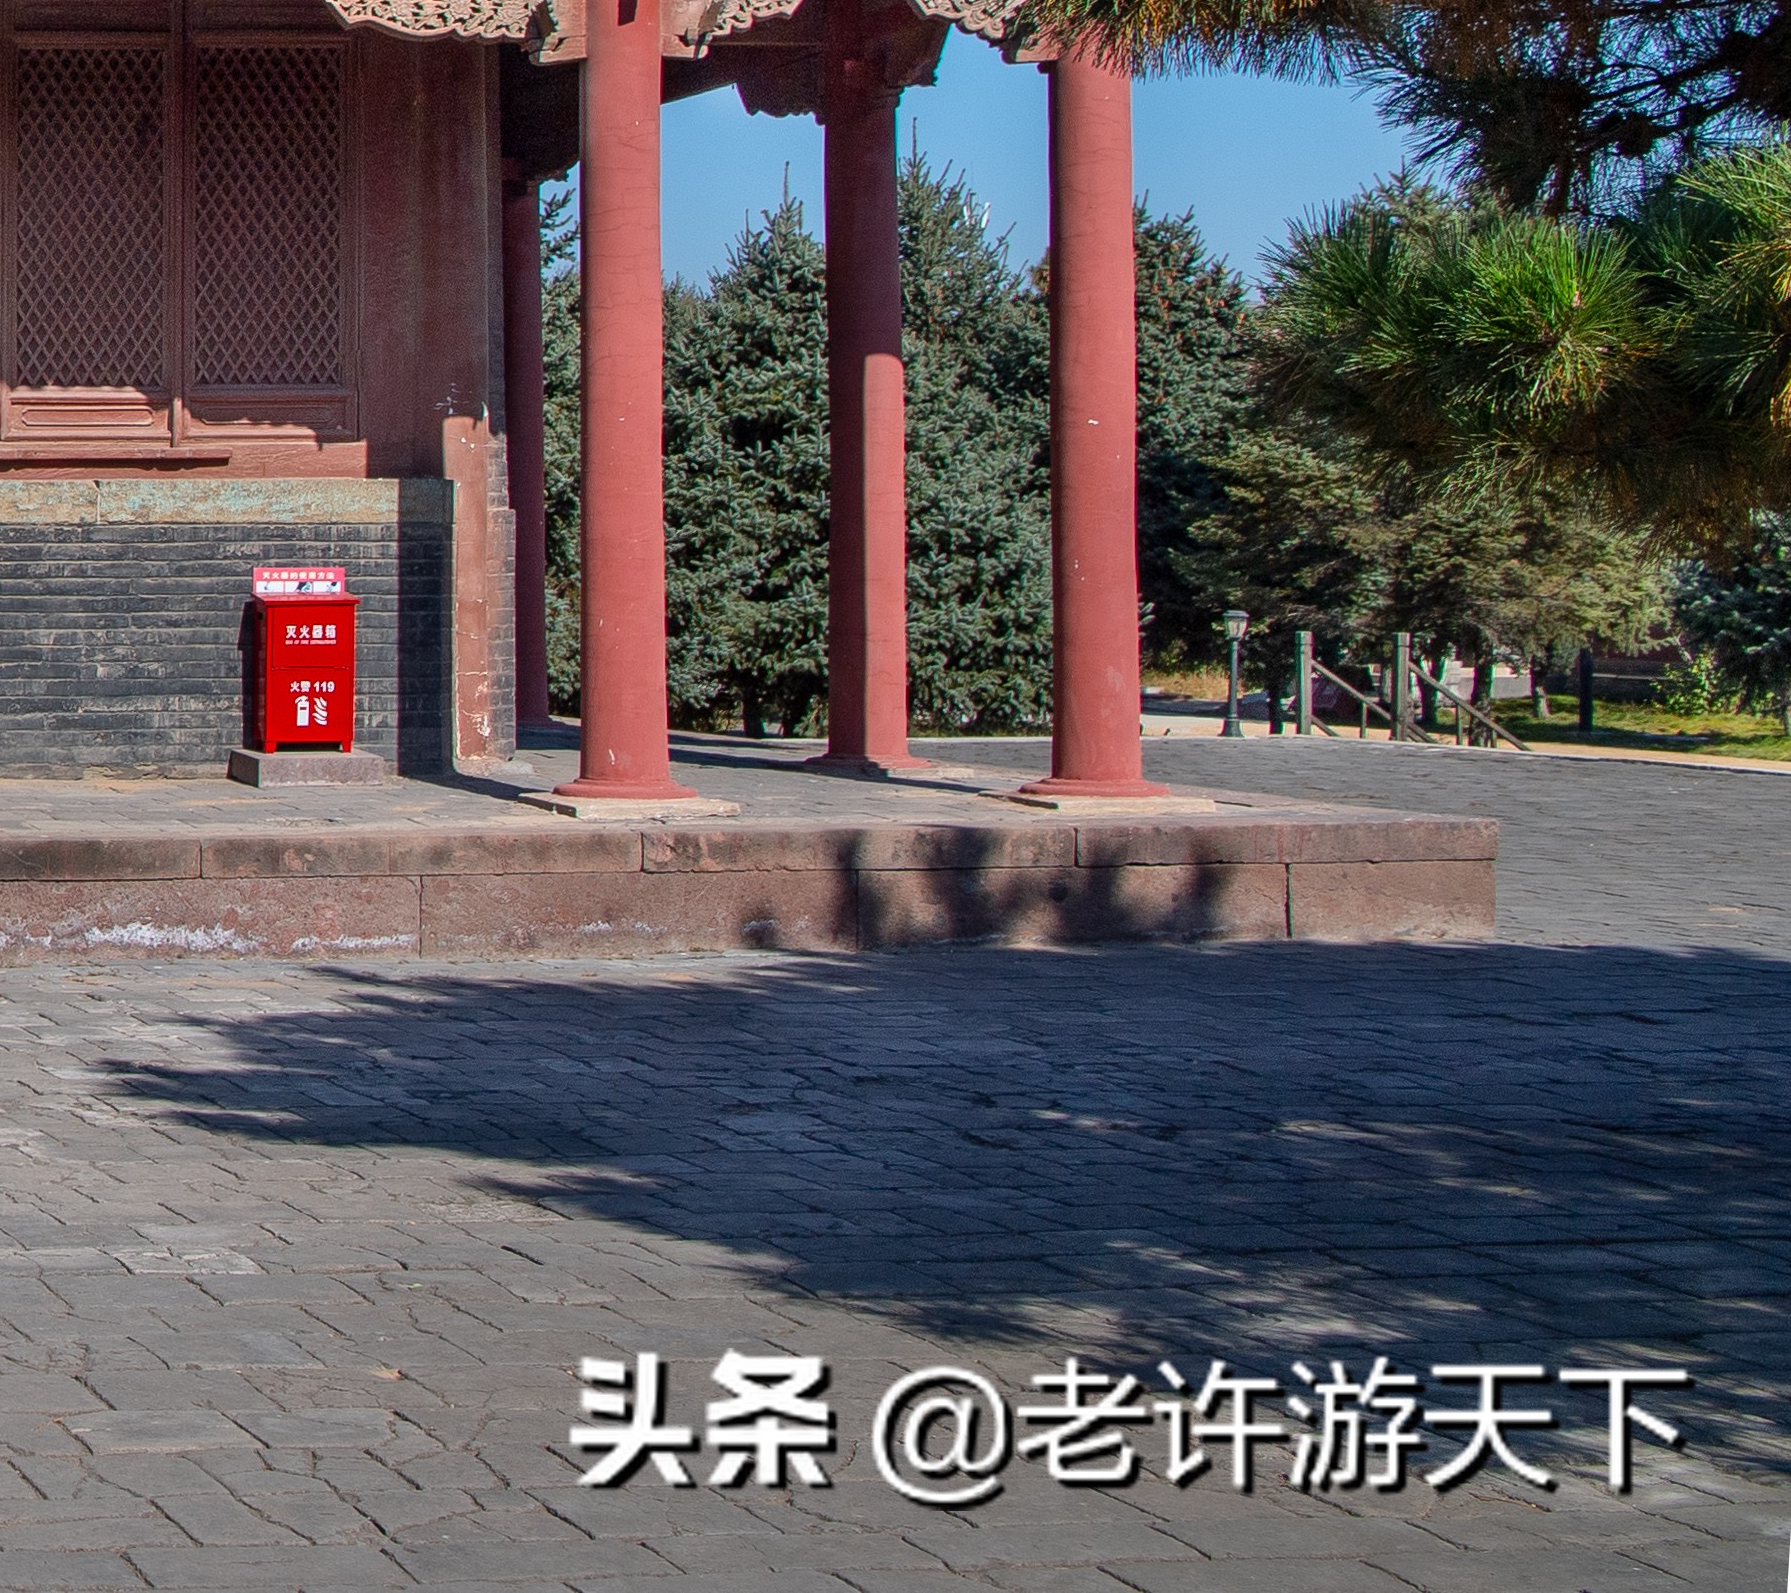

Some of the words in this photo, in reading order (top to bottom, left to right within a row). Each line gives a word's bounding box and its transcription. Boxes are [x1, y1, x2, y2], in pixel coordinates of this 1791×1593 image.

[285, 624, 336, 639] 灭火器箱
[290, 681, 311, 693] 火警
[313, 681, 335, 693] 119
